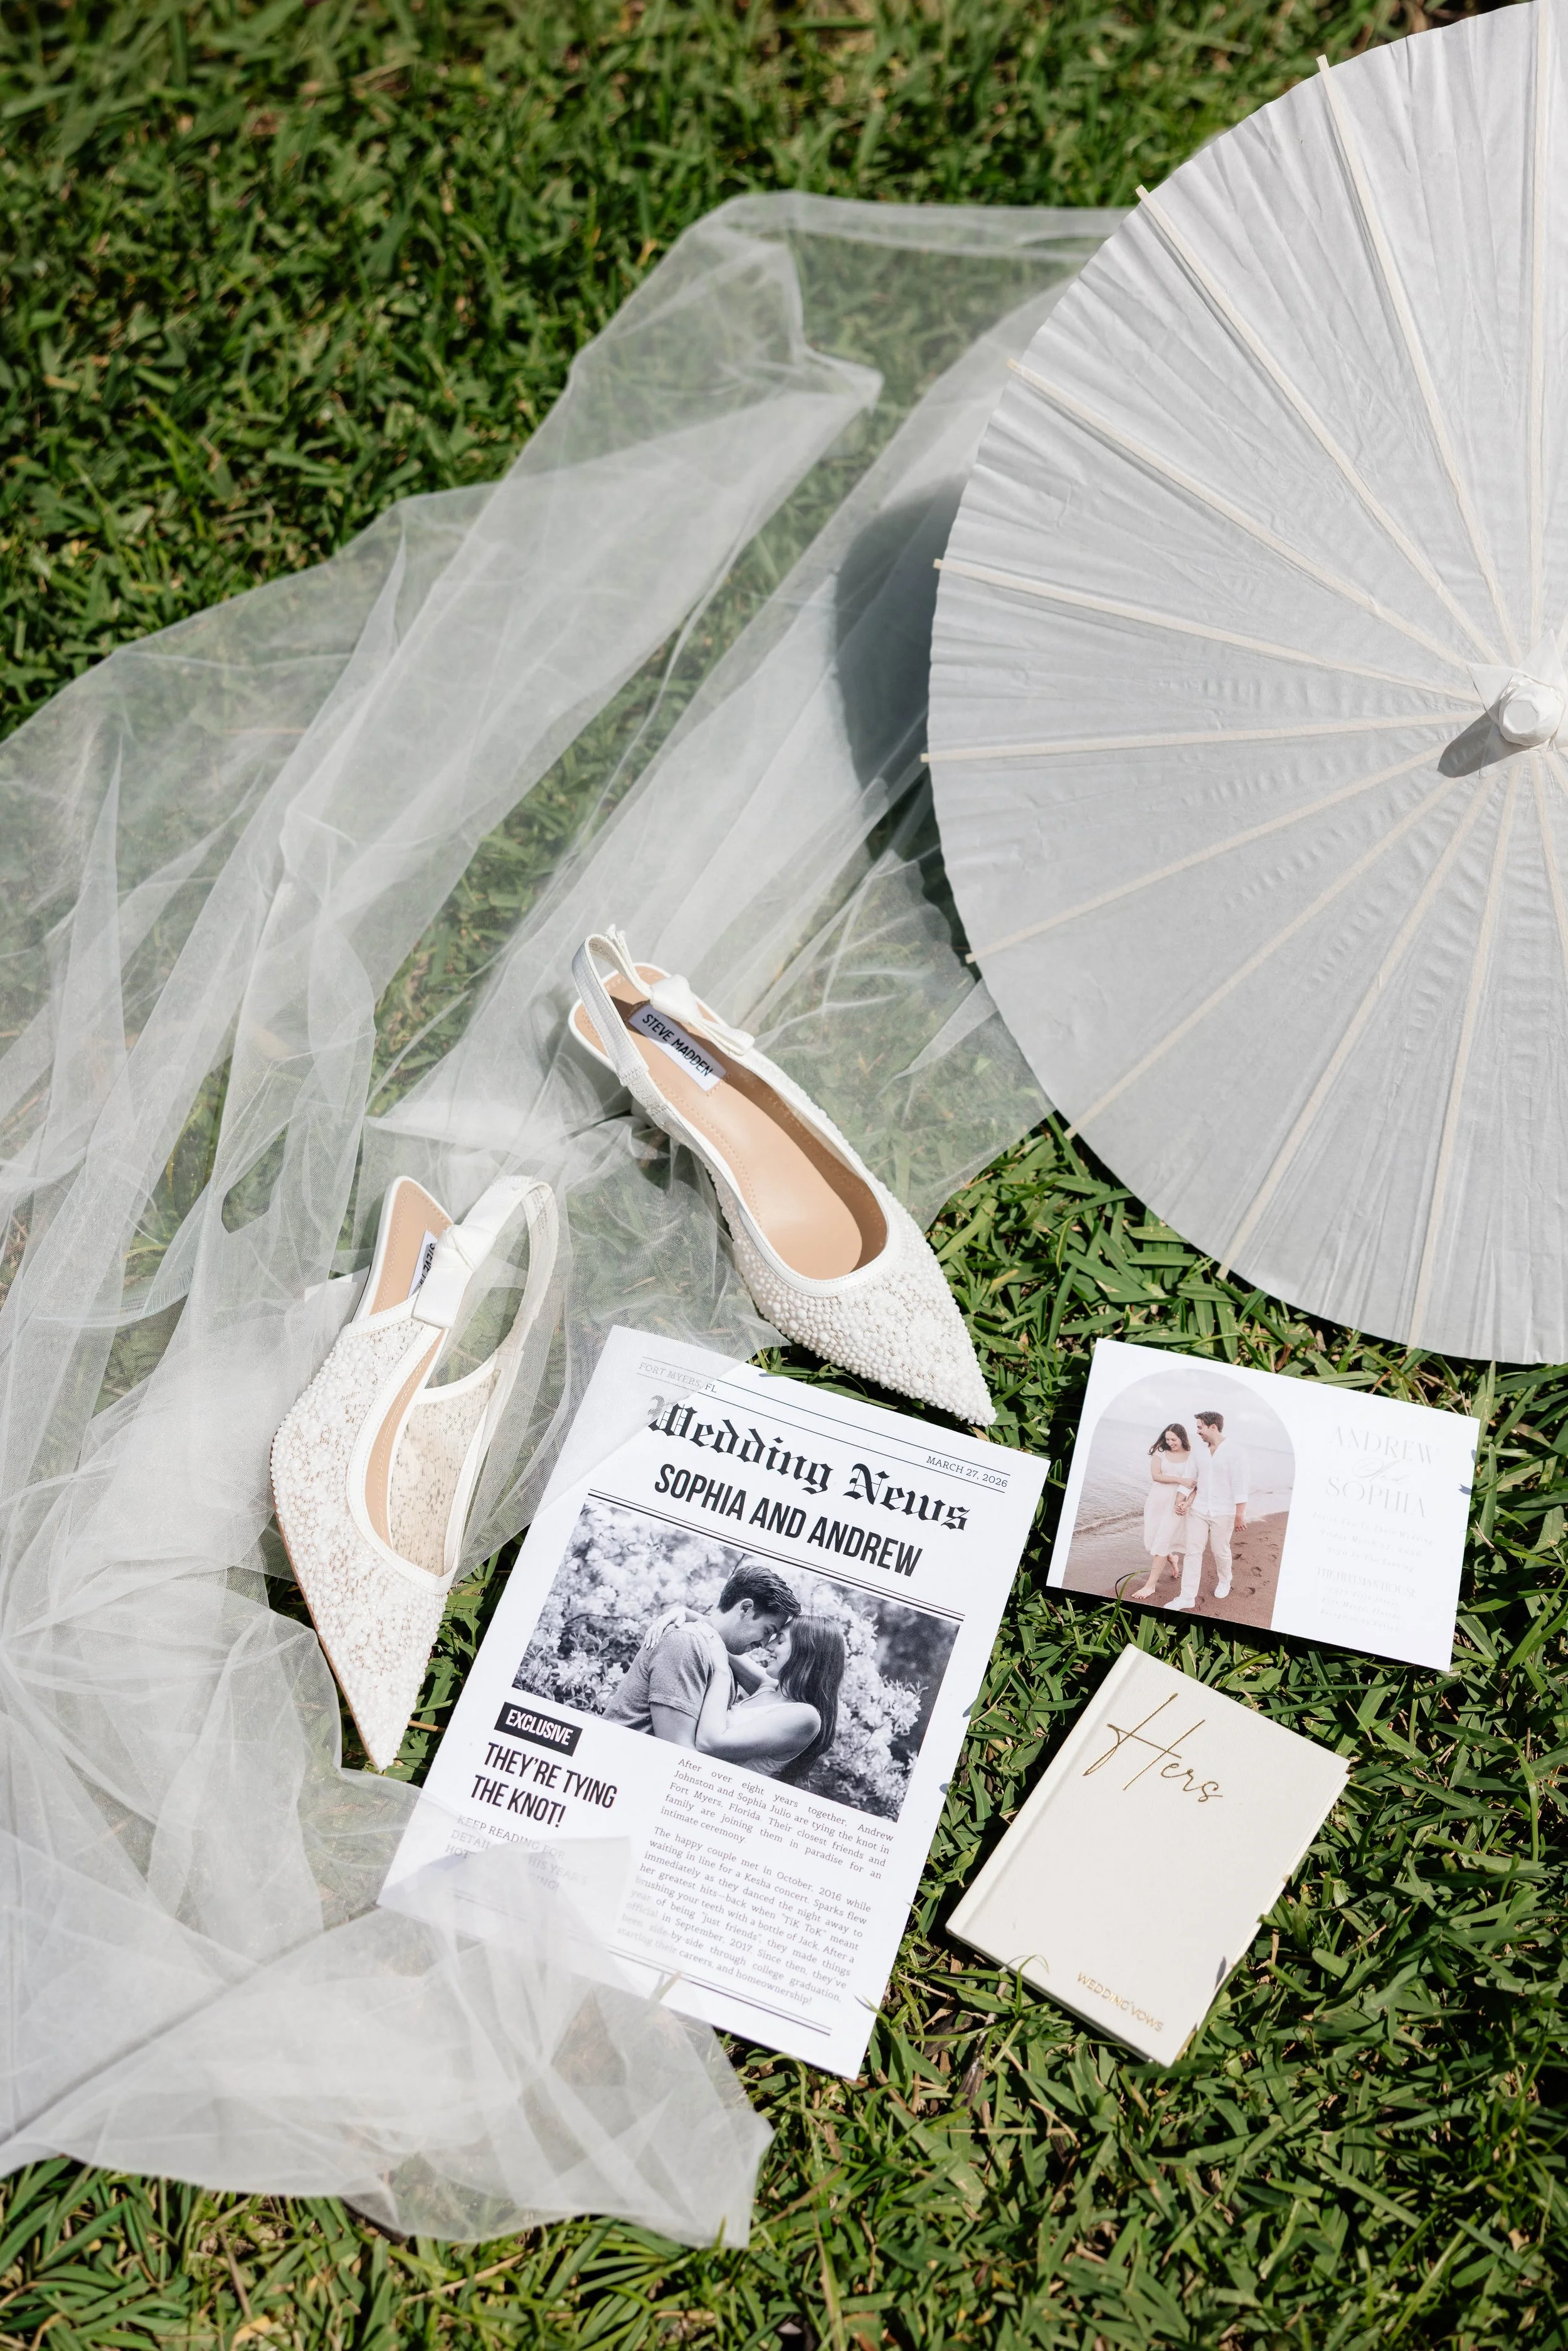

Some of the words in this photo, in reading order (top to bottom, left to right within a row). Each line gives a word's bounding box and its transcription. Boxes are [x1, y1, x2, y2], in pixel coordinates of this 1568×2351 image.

[642, 1014, 675, 1042] STEVE
[671, 1038, 713, 1076] MADDEN
[638, 1362, 666, 1376] FORT
[667, 1370, 702, 1389] MYERS,
[705, 1383, 717, 1393] FL
[647, 1394, 834, 1495] Wedding
[842, 1463, 971, 1531] News
[926, 1456, 964, 1473] MARCH
[965, 1468, 979, 1480] 27,
[982, 1473, 1008, 1487] 2026
[1328, 1425, 1439, 1465] ANDREW
[654, 1463, 747, 1521] SOPHIA
[748, 1497, 807, 1539] AND
[806, 1515, 924, 1578] ANDREW
[1325, 1476, 1426, 1517] SOPHIA
[505, 1709, 574, 1746] EXCLUSIVE
[1082, 1692, 1224, 1803] Hers
[471, 1774, 509, 1807] THE
[507, 1788, 566, 1828] KNOT!
[484, 1741, 563, 1789] THEY'RE
[563, 1769, 618, 1808] TYING
[674, 1770, 714, 1790] Johnston
[717, 1787, 734, 1797] and
[737, 1792, 766, 1810] Sophia
[770, 1805, 792, 1818] Julio
[794, 1815, 809, 1825] are
[812, 1822, 836, 1837] tying
[838, 1830, 853, 1842] the
[856, 1835, 877, 1850] knot
[880, 1844, 889, 1854] in
[678, 1758, 702, 1772] After
[711, 1771, 733, 1783] over
[741, 1781, 764, 1795] eight
[773, 1794, 798, 1808] years
[857, 1823, 894, 1842] Andrew
[457, 1814, 487, 1830] KEEP
[488, 1825, 540, 1851] READING
[541, 1844, 566, 1860] FOR
[660, 1806, 699, 1825] intimate
[665, 1793, 695, 1812] family
[700, 1808, 716, 1818] are
[719, 1813, 753, 1834] joining
[760, 1828, 783, 1843] them
[790, 1839, 798, 1849] in
[804, 1847, 843, 1865] paradise
[849, 1861, 864, 1872] for
[869, 1871, 881, 1879] an
[669, 1781, 689, 1795] Fort
[768, 1817, 793, 1832] Their
[797, 1829, 827, 1846] closest
[832, 1841, 864, 1859] friends
[868, 1856, 886, 1867] and
[639, 1863, 656, 1875] her
[658, 1872, 696, 1889] greatest
[751, 1905, 776, 1919] when
[830, 1934, 859, 1951] meant
[644, 1850, 701, 1879] immediately
[704, 1874, 715, 1882] as
[717, 1879, 738, 1895] they
[743, 1887, 775, 1905] danced
[778, 1901, 793, 1912] the
[797, 1909, 822, 1923] night
[825, 1919, 850, 1934] away
[853, 1929, 863, 1938] to
[650, 1840, 683, 1859] waiting
[686, 1851, 696, 1861] in
[698, 1855, 716, 1868] line
[719, 1863, 733, 1874] for
[744, 1872, 771, 1889] Kesha
[813, 1899, 844, 1916] Sparks
[847, 1911, 867, 1924] flew
[654, 1826, 671, 1839] The
[674, 1834, 703, 1851] happy
[707, 1847, 737, 1862] couple
[741, 1859, 759, 1871] met
[763, 1865, 772, 1876] in
[818, 1887, 842, 1901] 2016
[846, 1898, 871, 1913] while
[622, 1913, 644, 1928] been
[649, 1926, 704, 1950] side-by-side
[709, 1946, 746, 1966] through
[752, 1963, 785, 1980] college
[626, 1902, 659, 1918] official
[662, 1913, 671, 1923] in
[757, 1949, 781, 1964] Since
[630, 1889, 652, 1902] year
[655, 1899, 667, 1907] of
[670, 1902, 696, 1920] being
[767, 1939, 788, 1954] they
[792, 1949, 817, 1963] made
[822, 1960, 851, 1977] things
[634, 1876, 675, 1899] brushing
[675, 1892, 699, 1904] your
[701, 1900, 724, 1914] teeth
[728, 1910, 748, 1923] with
[758, 1920, 785, 1937] bottle
[787, 1933, 797, 1941] of
[822, 1945, 847, 1960] After
[617, 1928, 654, 1947] starting
[655, 1940, 678, 1955] their
[716, 1964, 734, 1975] and
[735, 1969, 812, 2006] homeownership!
[1077, 1971, 1130, 2011] WEDDING
[1131, 2003, 1164, 2032] VOWS
